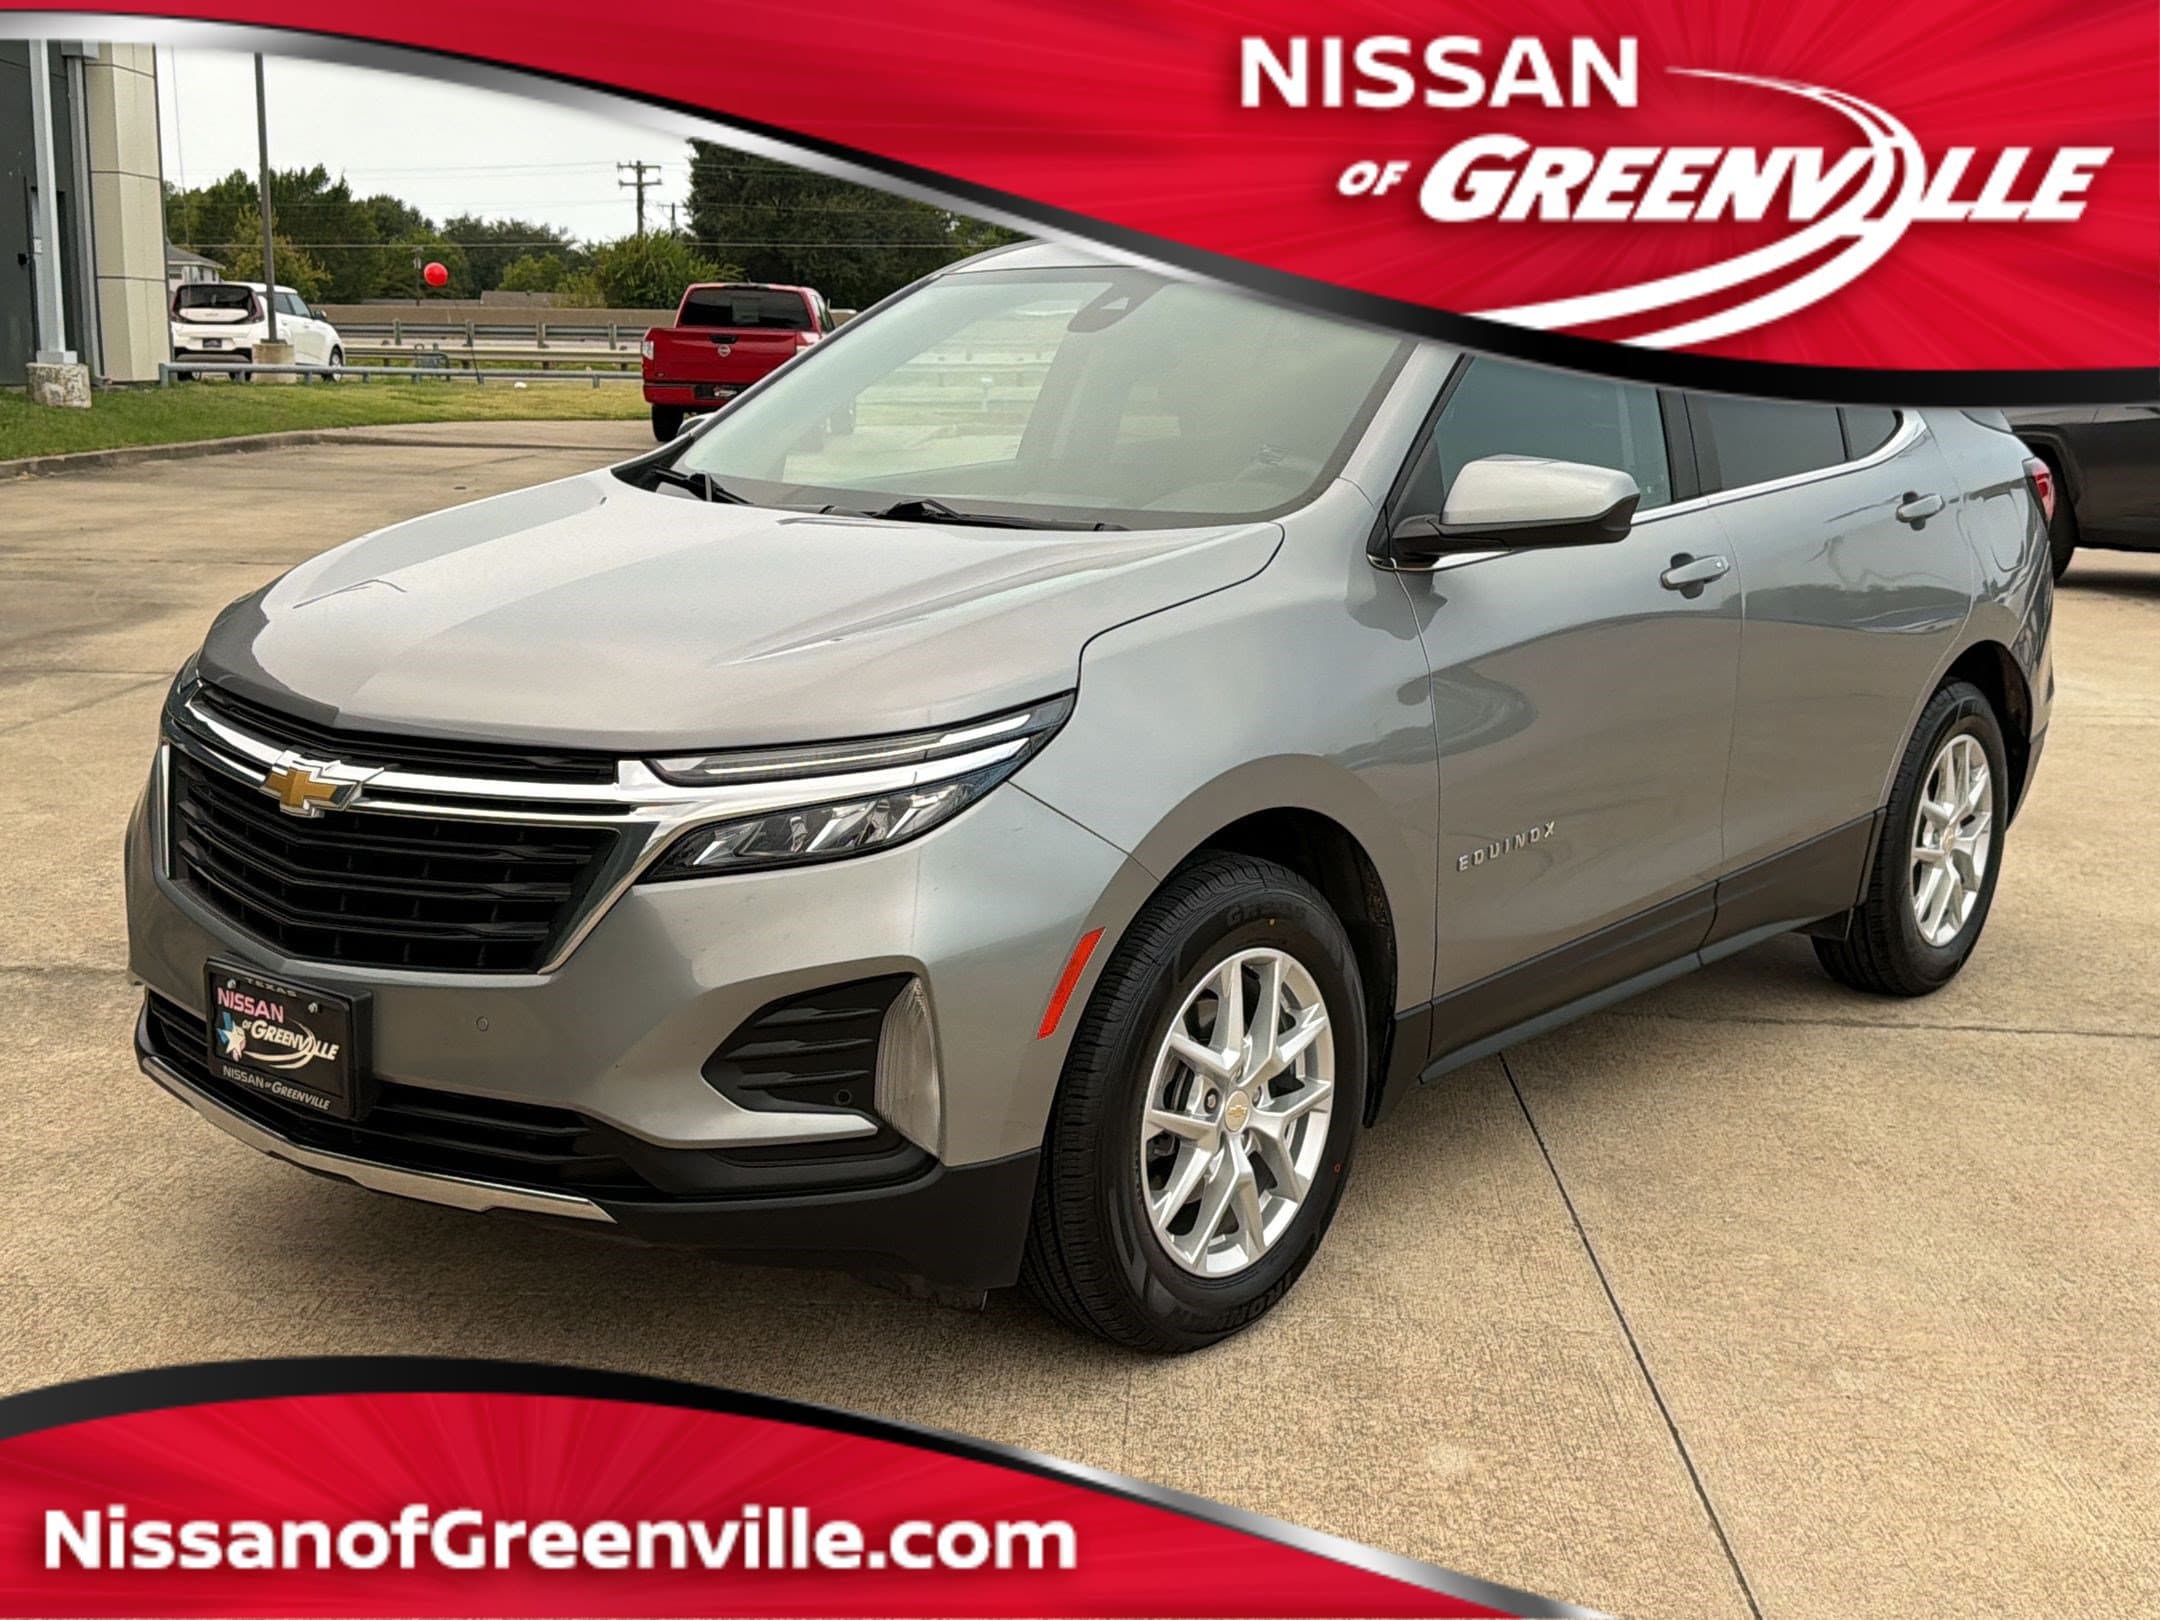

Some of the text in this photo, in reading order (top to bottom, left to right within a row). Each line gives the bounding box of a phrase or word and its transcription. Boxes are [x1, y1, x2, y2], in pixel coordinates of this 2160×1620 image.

[1457, 820, 1555, 872] EQUINOX
[217, 987, 284, 1023] NISSAN
[245, 977, 297, 997] TEXAS
[251, 1019, 340, 1061] GREENVILLE
[223, 1065, 266, 1089] NISSAN
[271, 1081, 330, 1110] GREENVILLE
